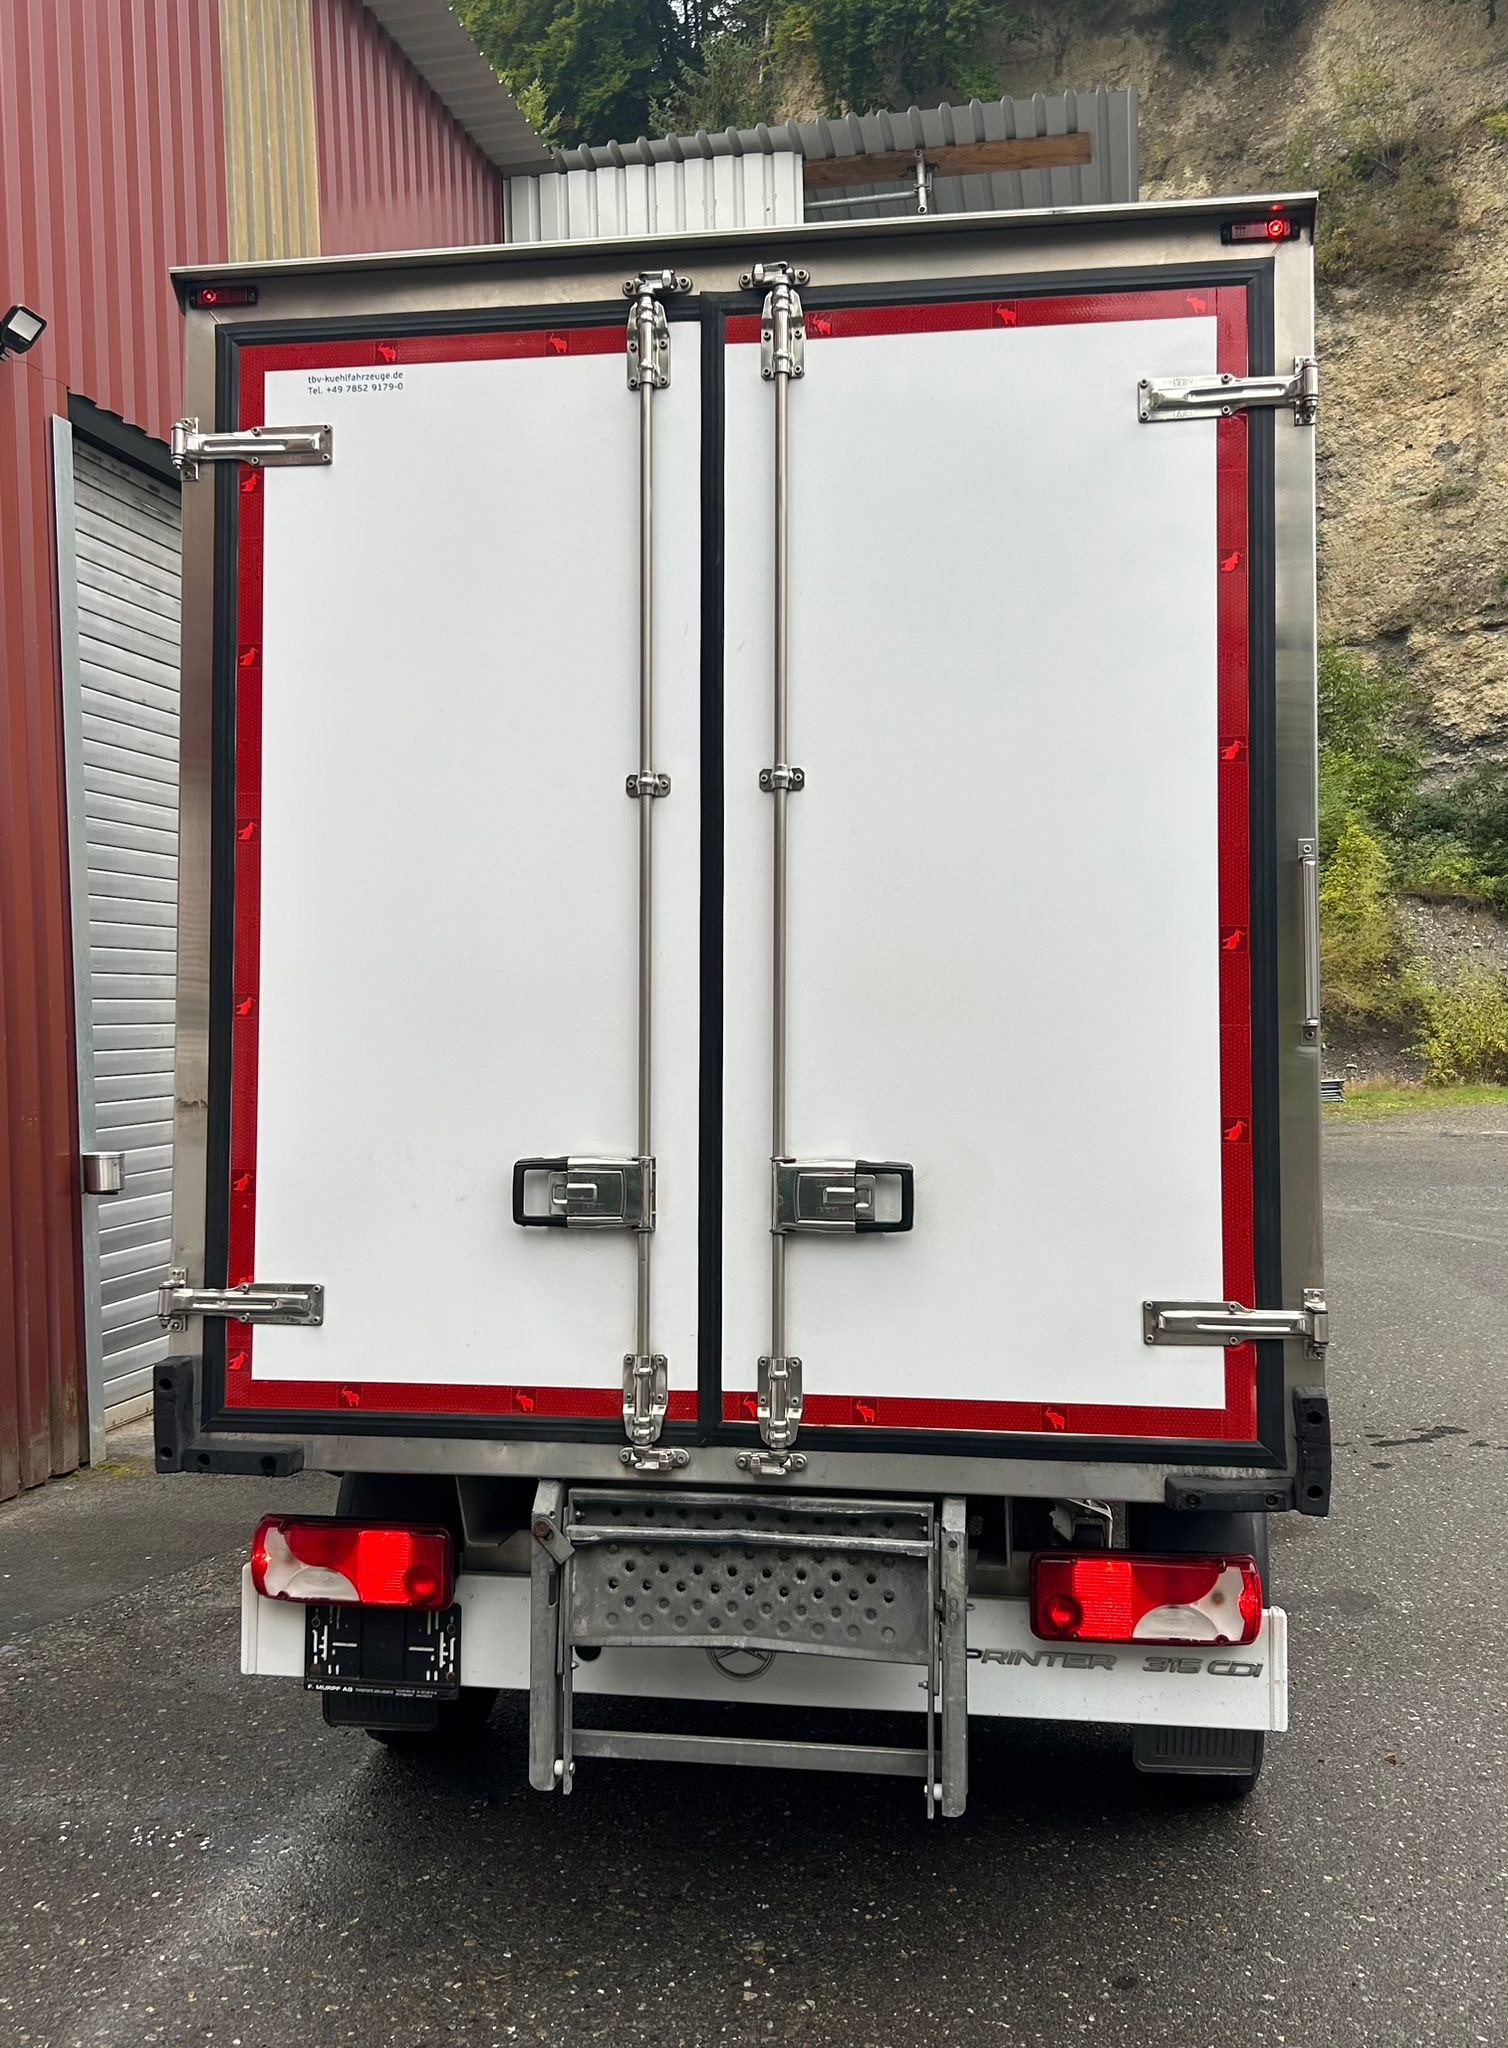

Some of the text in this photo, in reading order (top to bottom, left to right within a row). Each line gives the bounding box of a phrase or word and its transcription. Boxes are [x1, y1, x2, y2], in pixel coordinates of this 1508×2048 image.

[308, 371, 404, 384] tbv-kuehlfahrzeuge.de
[308, 382, 404, 395] Tel. +49 7852 9179-0
[966, 1647, 1264, 1677] PRINTER 315 CDI
